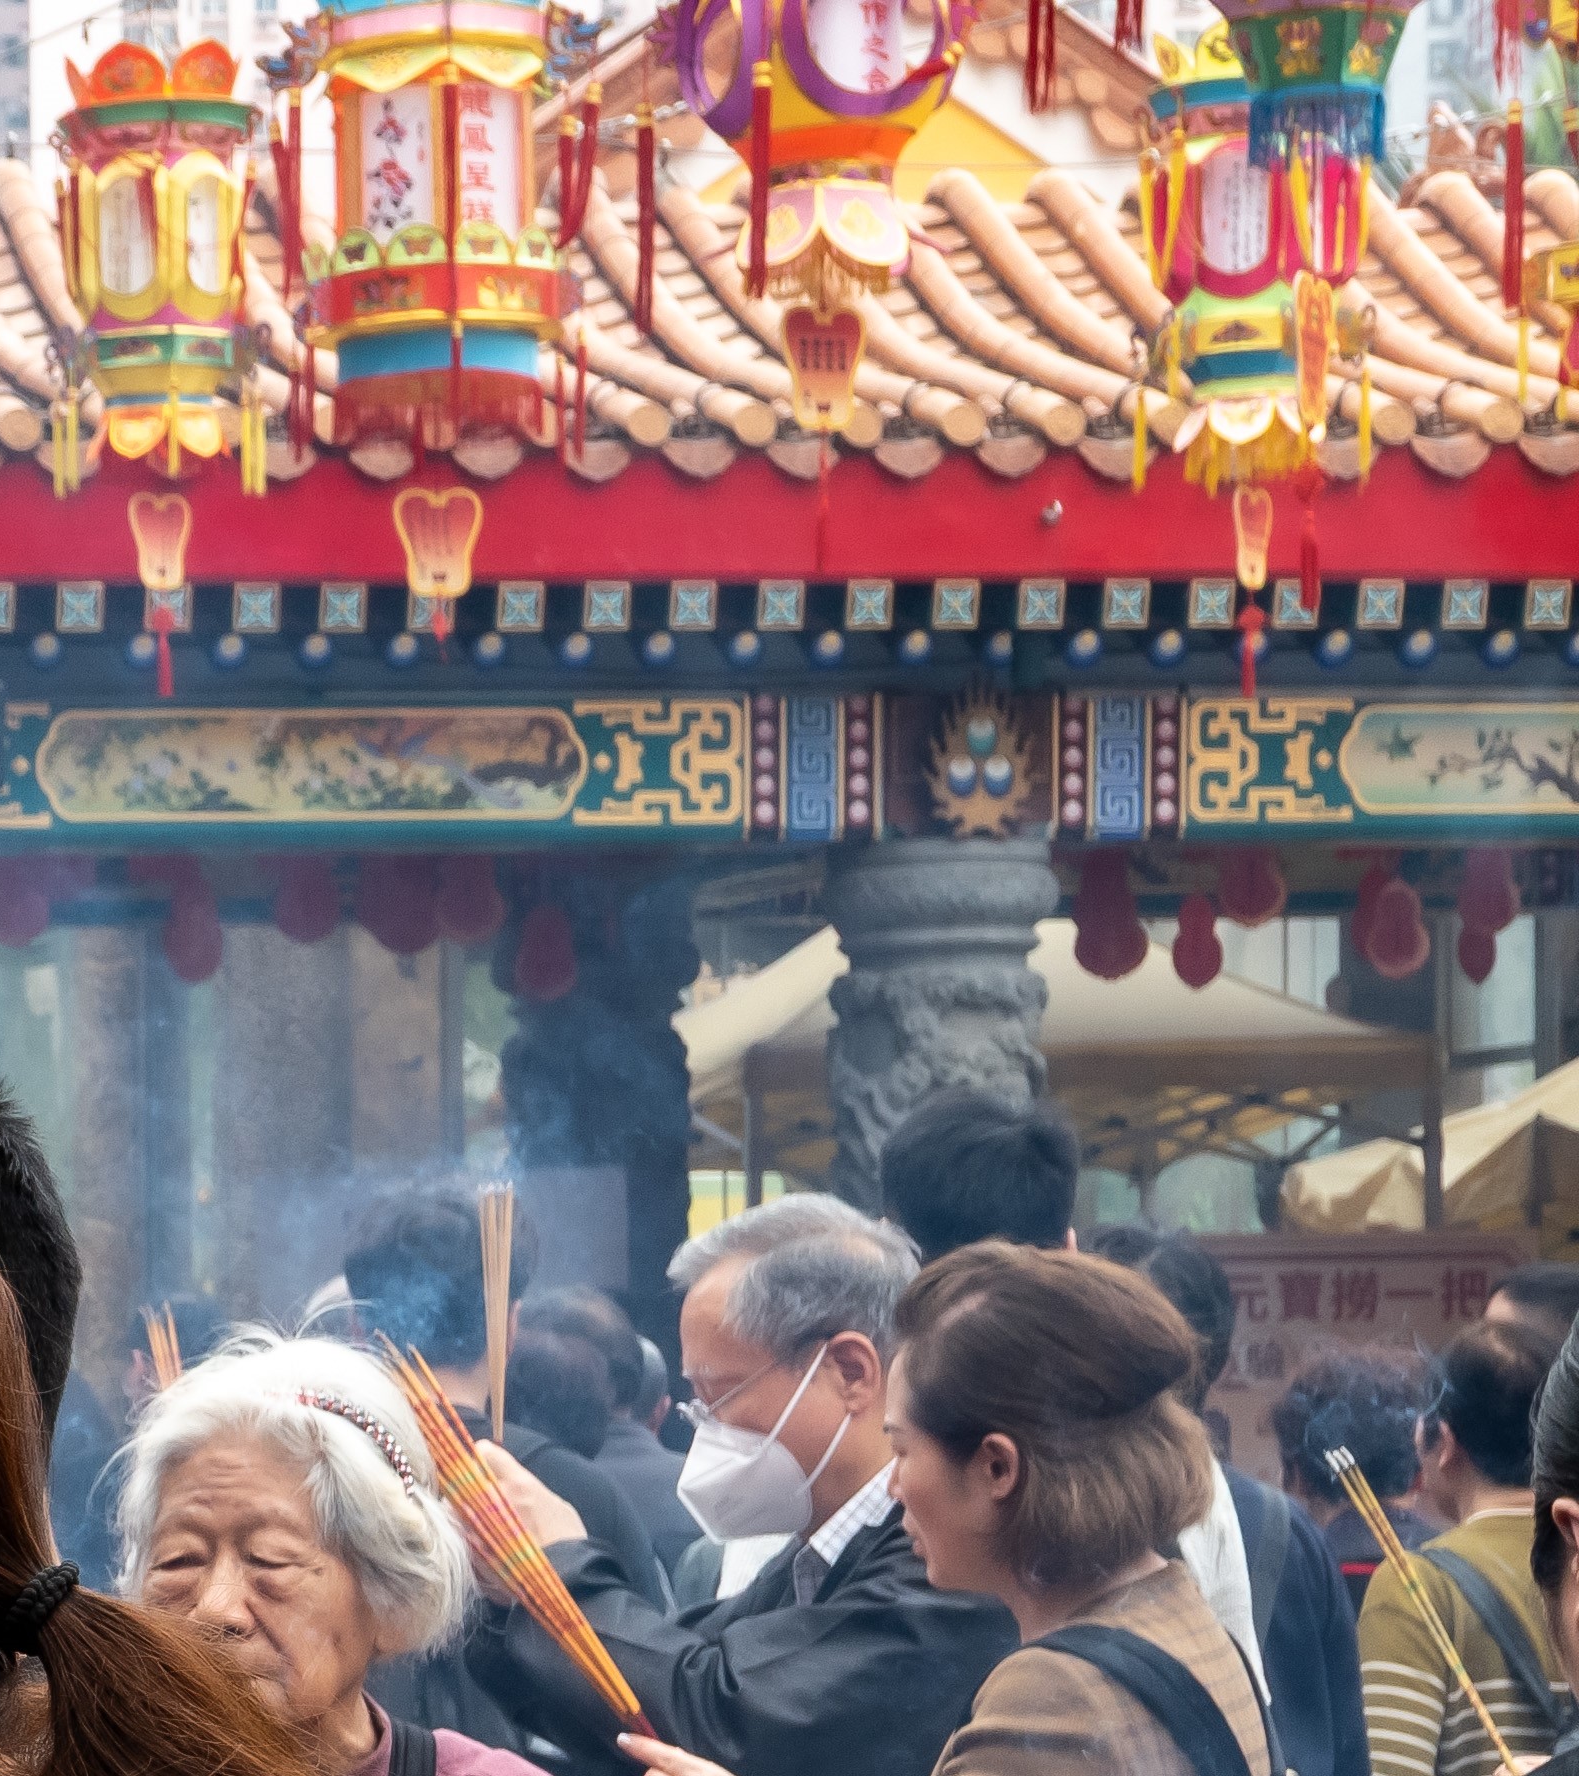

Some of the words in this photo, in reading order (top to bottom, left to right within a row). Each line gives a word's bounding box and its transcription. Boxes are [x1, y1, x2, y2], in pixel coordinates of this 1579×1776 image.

[1230, 1267, 1488, 1323] 元寶撈一把
